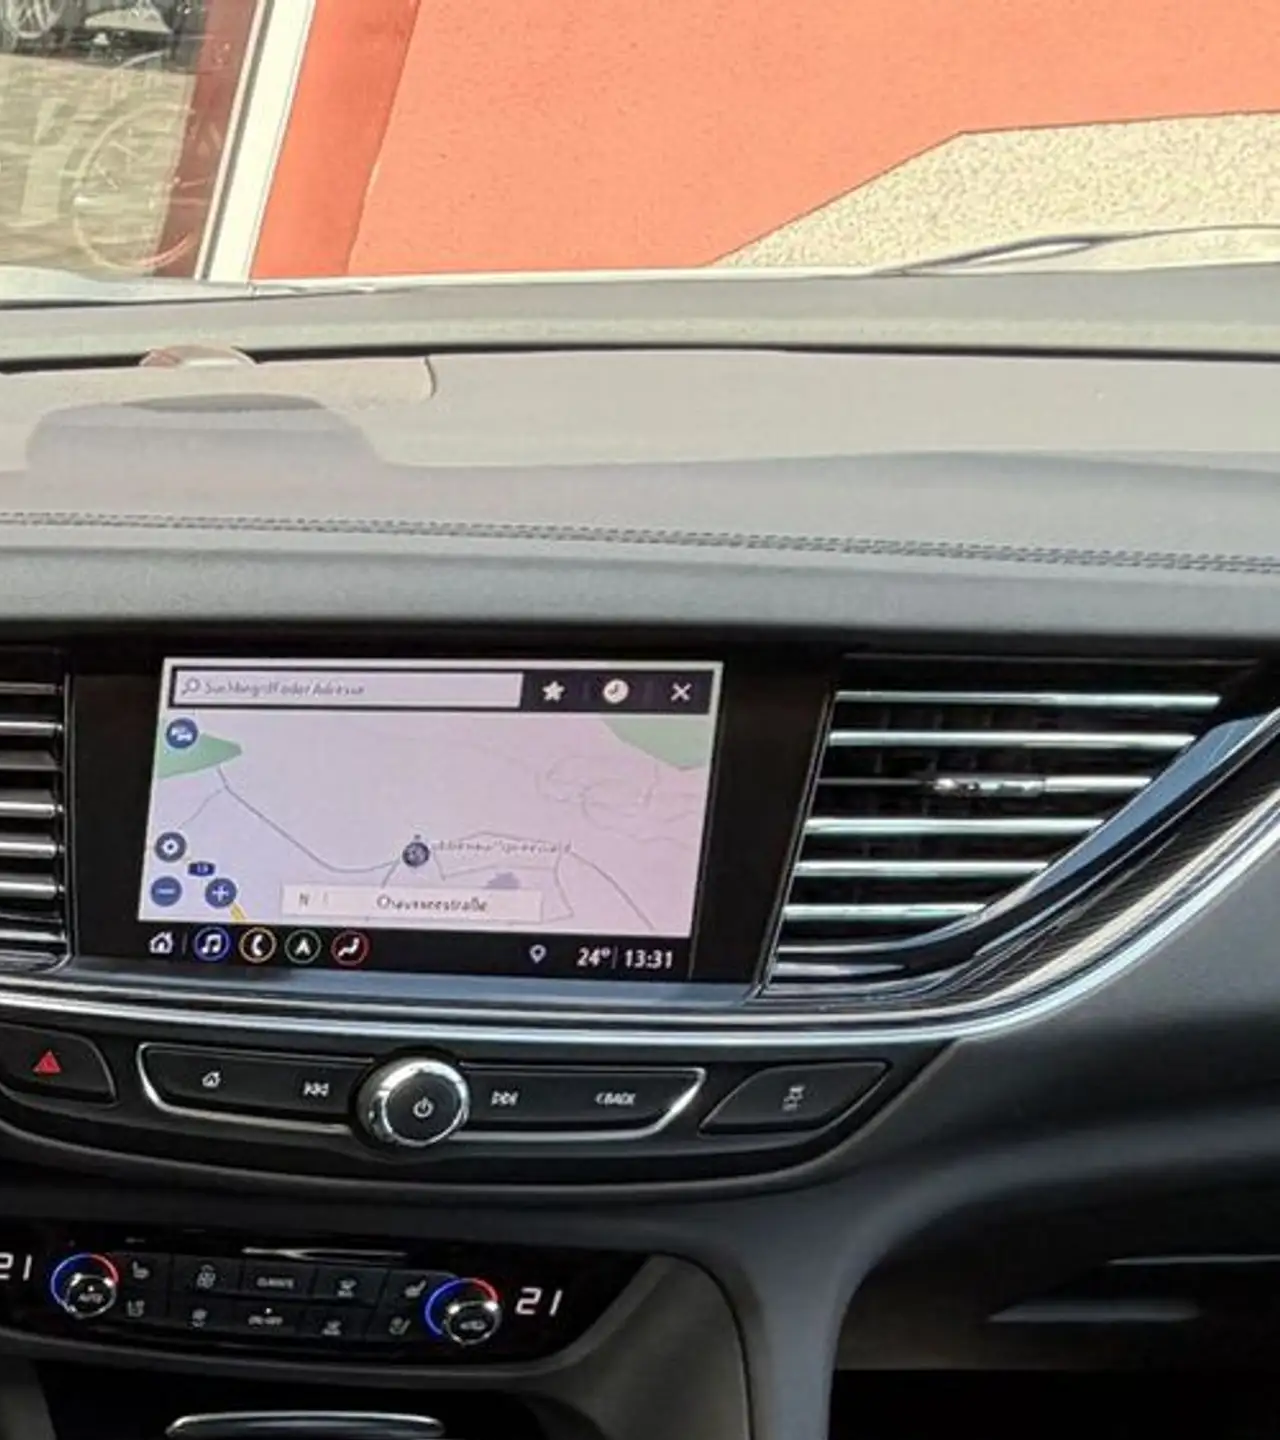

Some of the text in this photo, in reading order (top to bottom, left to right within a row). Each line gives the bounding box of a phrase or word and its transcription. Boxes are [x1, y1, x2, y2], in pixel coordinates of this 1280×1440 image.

[576, 947, 673, 969] 24° 13:31
[515, 1286, 562, 1316] 21
